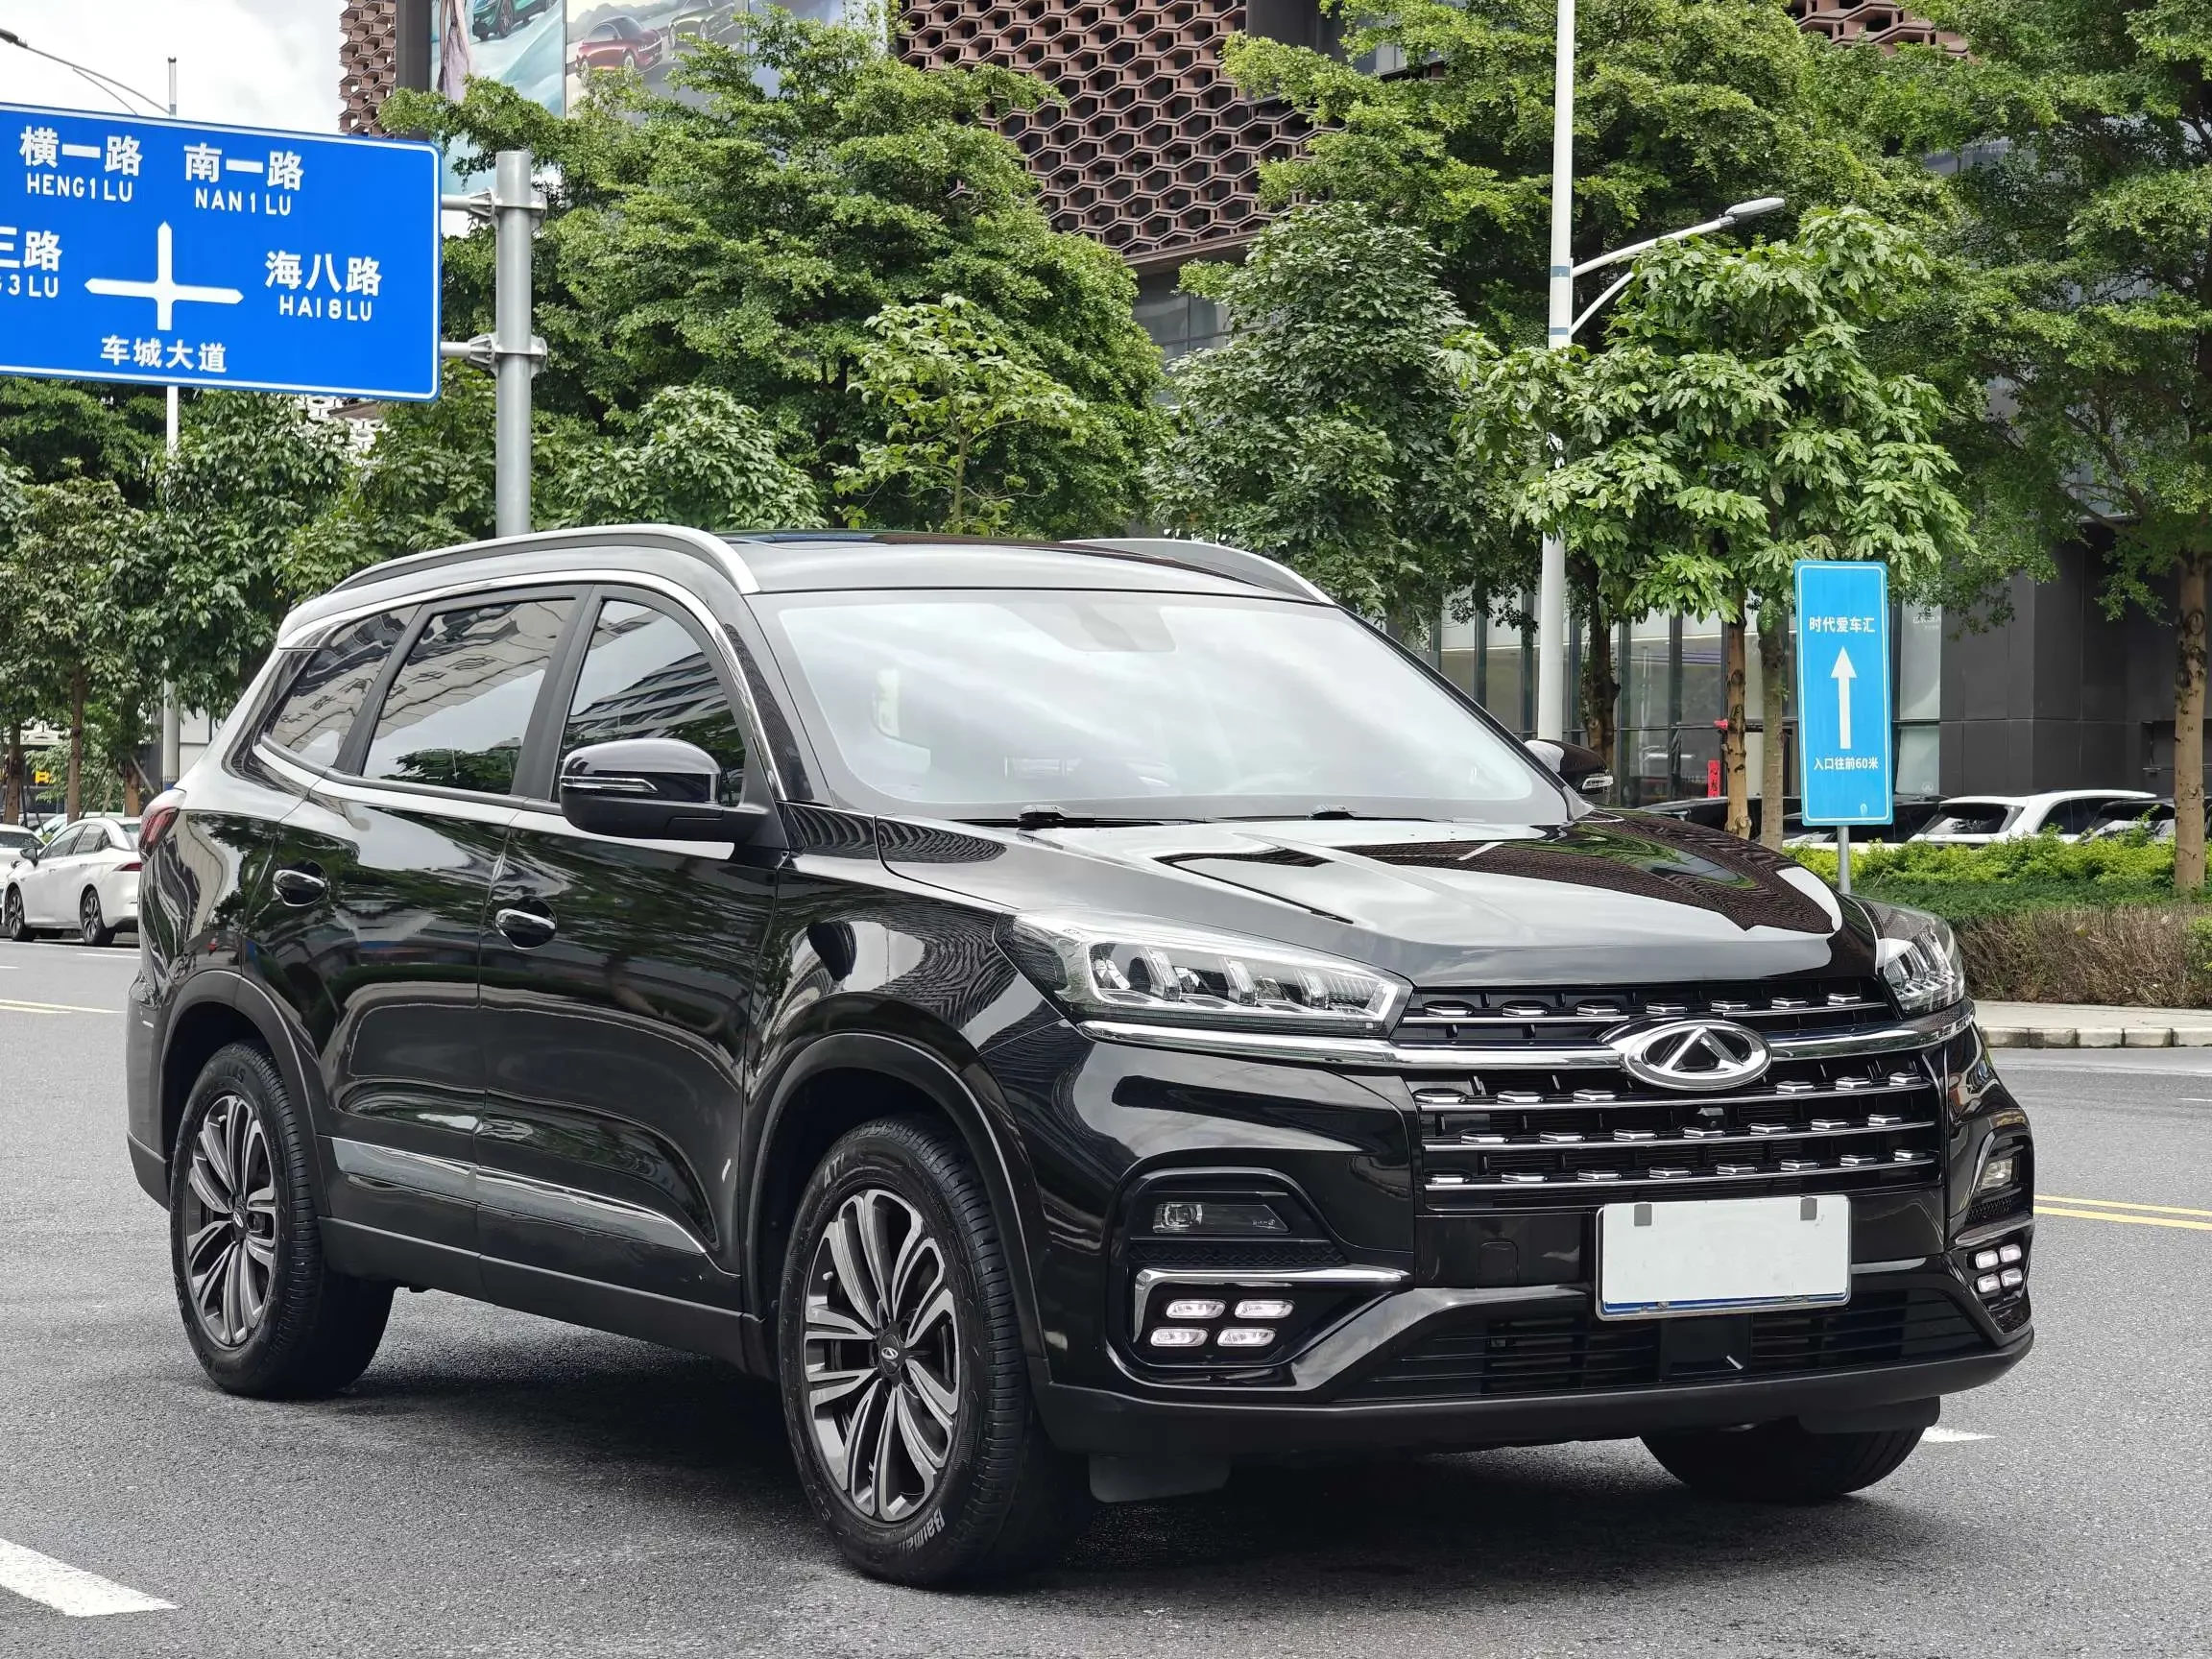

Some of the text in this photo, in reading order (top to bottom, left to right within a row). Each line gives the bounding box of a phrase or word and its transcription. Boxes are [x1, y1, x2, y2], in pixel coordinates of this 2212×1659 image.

[19, 126, 143, 177] 横一路
[183, 142, 304, 191] 南一路
[264, 250, 382, 297] 海八路
[100, 334, 228, 373] 车城大道
[1809, 616, 1875, 634] 时代爱车汇
[1813, 757, 1879, 771] 入口往前60米
